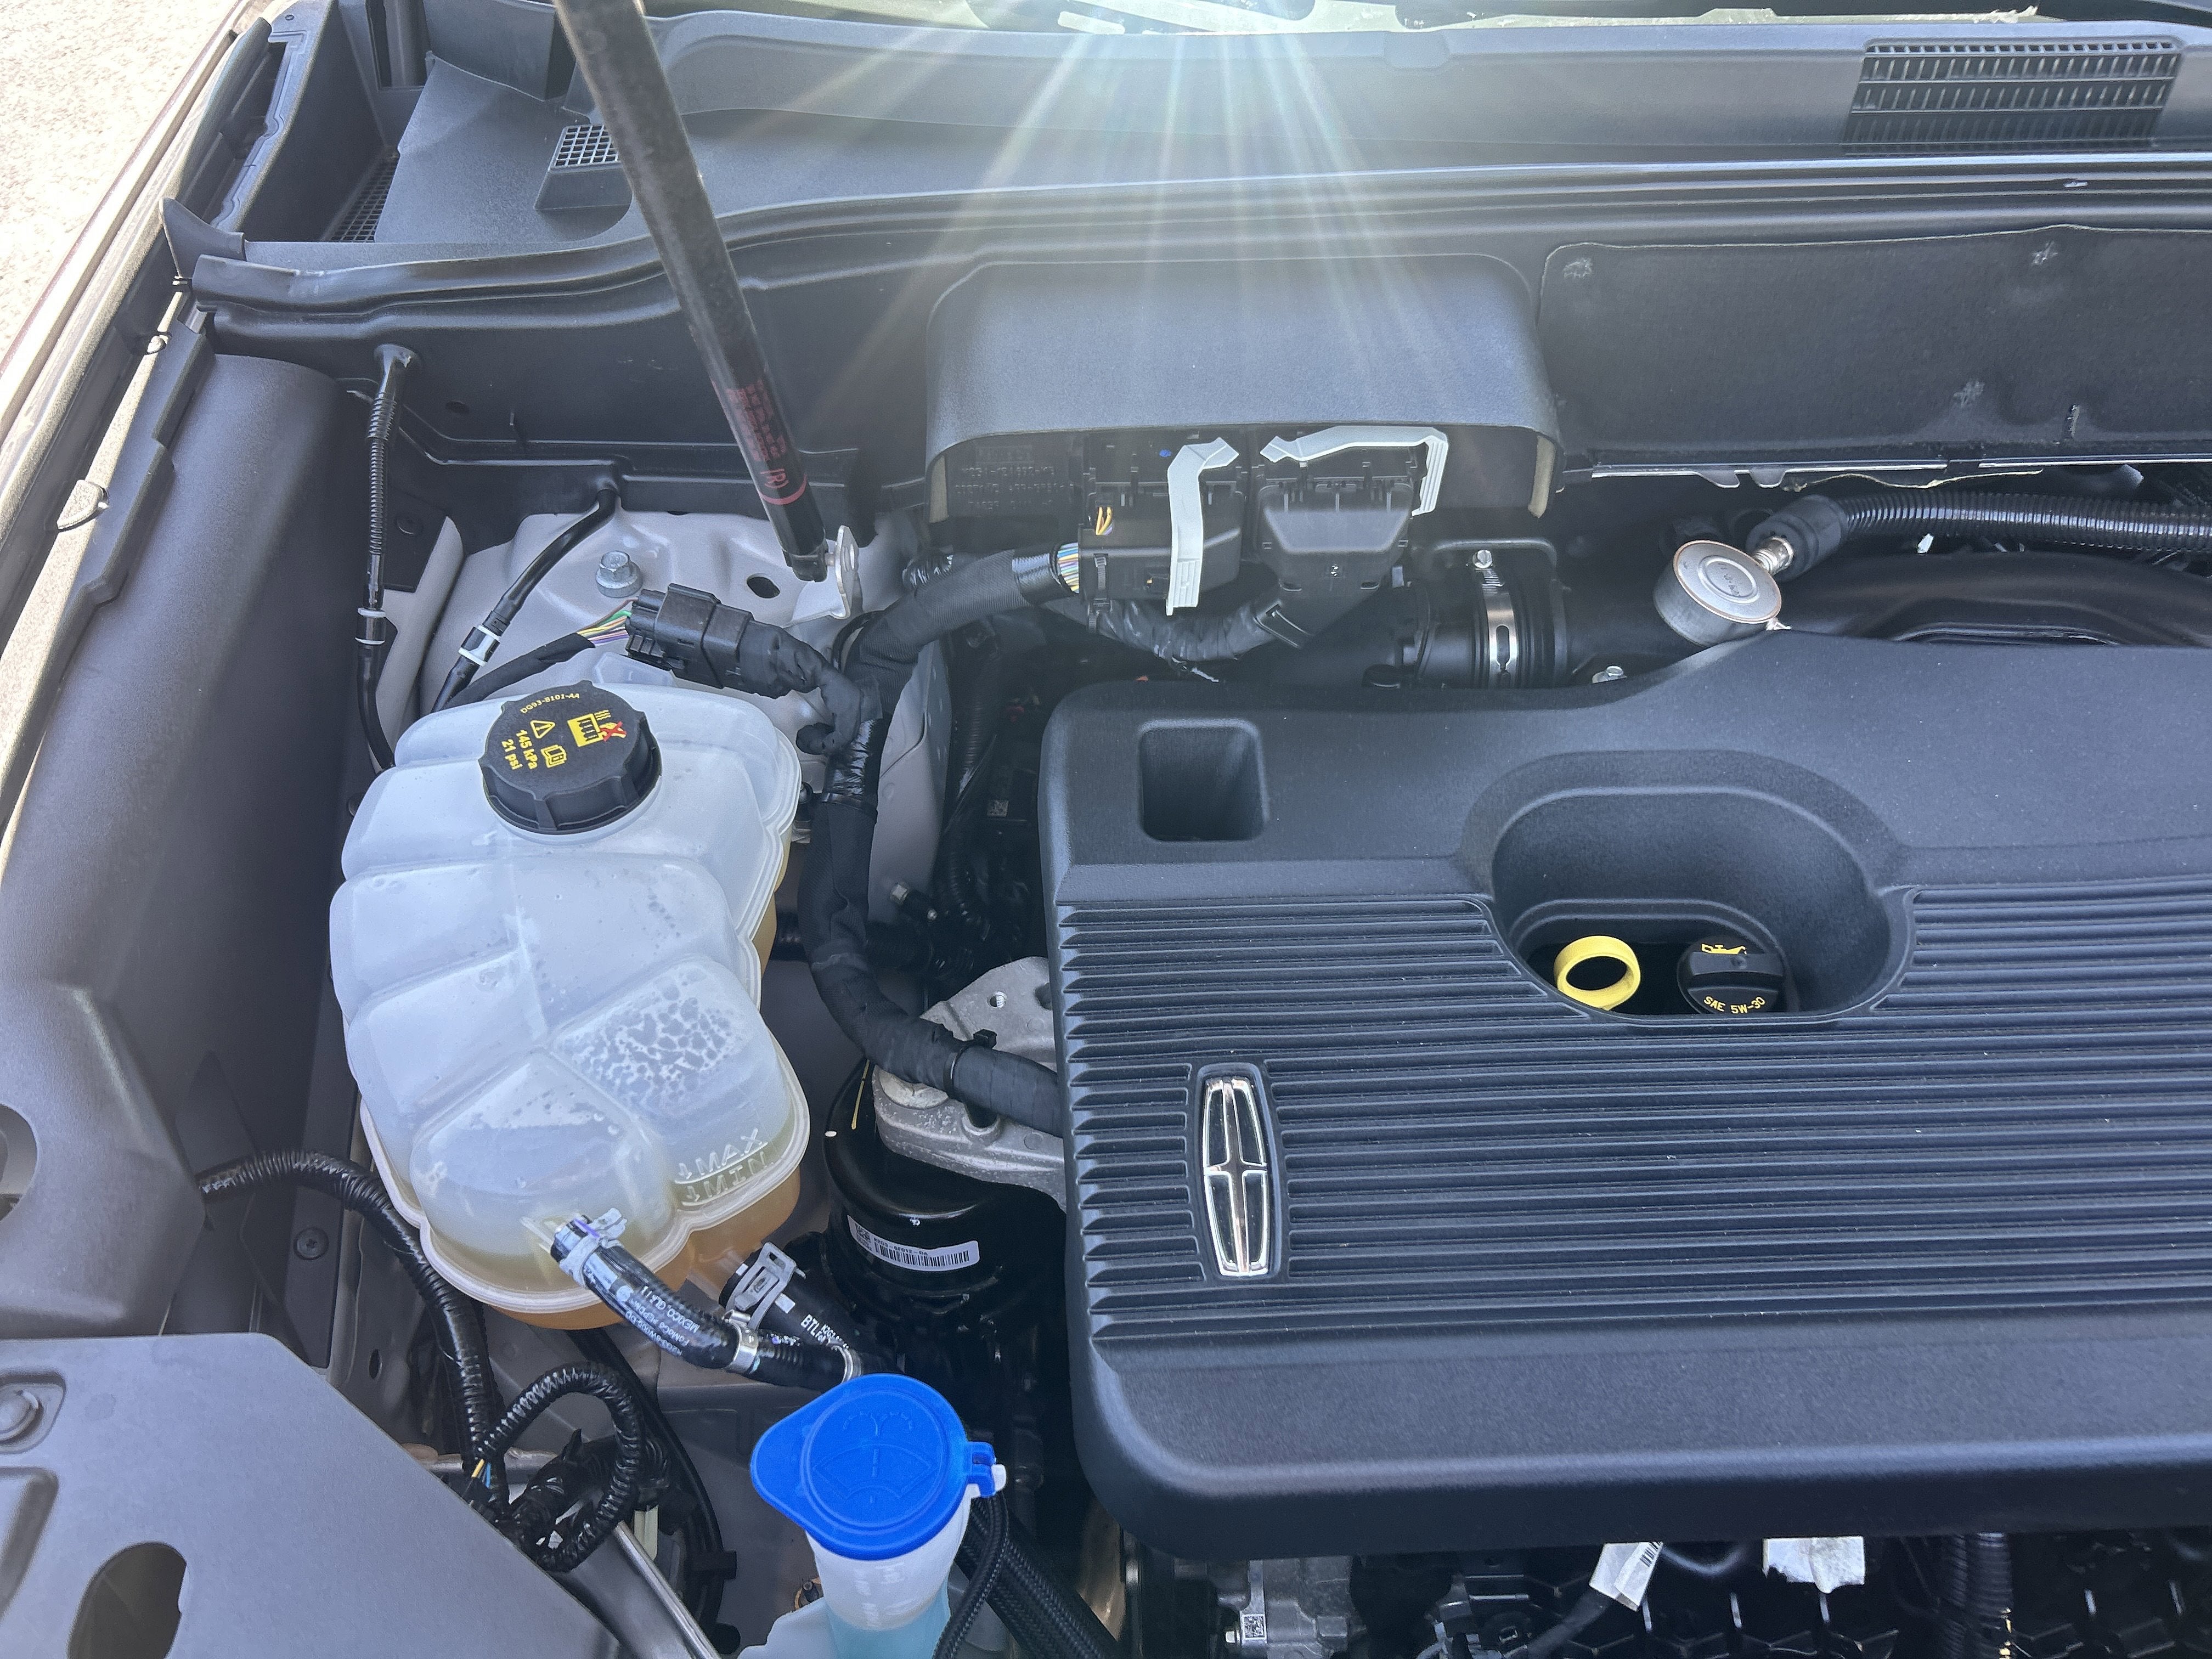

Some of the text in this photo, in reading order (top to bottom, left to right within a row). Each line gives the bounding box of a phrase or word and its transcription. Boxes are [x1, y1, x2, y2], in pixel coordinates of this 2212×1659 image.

[520, 693, 580, 714] DG93-8101-AA
[501, 738, 523, 770] 21 psi
[516, 730, 538, 770] 145 kPa
[1703, 996, 1765, 1014] SAE 5W-30
[695, 1127, 763, 1176] MAX
[703, 1151, 768, 1197] MIN
[659, 1322, 690, 1347] FoMoCo
[800, 1314, 820, 1336] BTL
